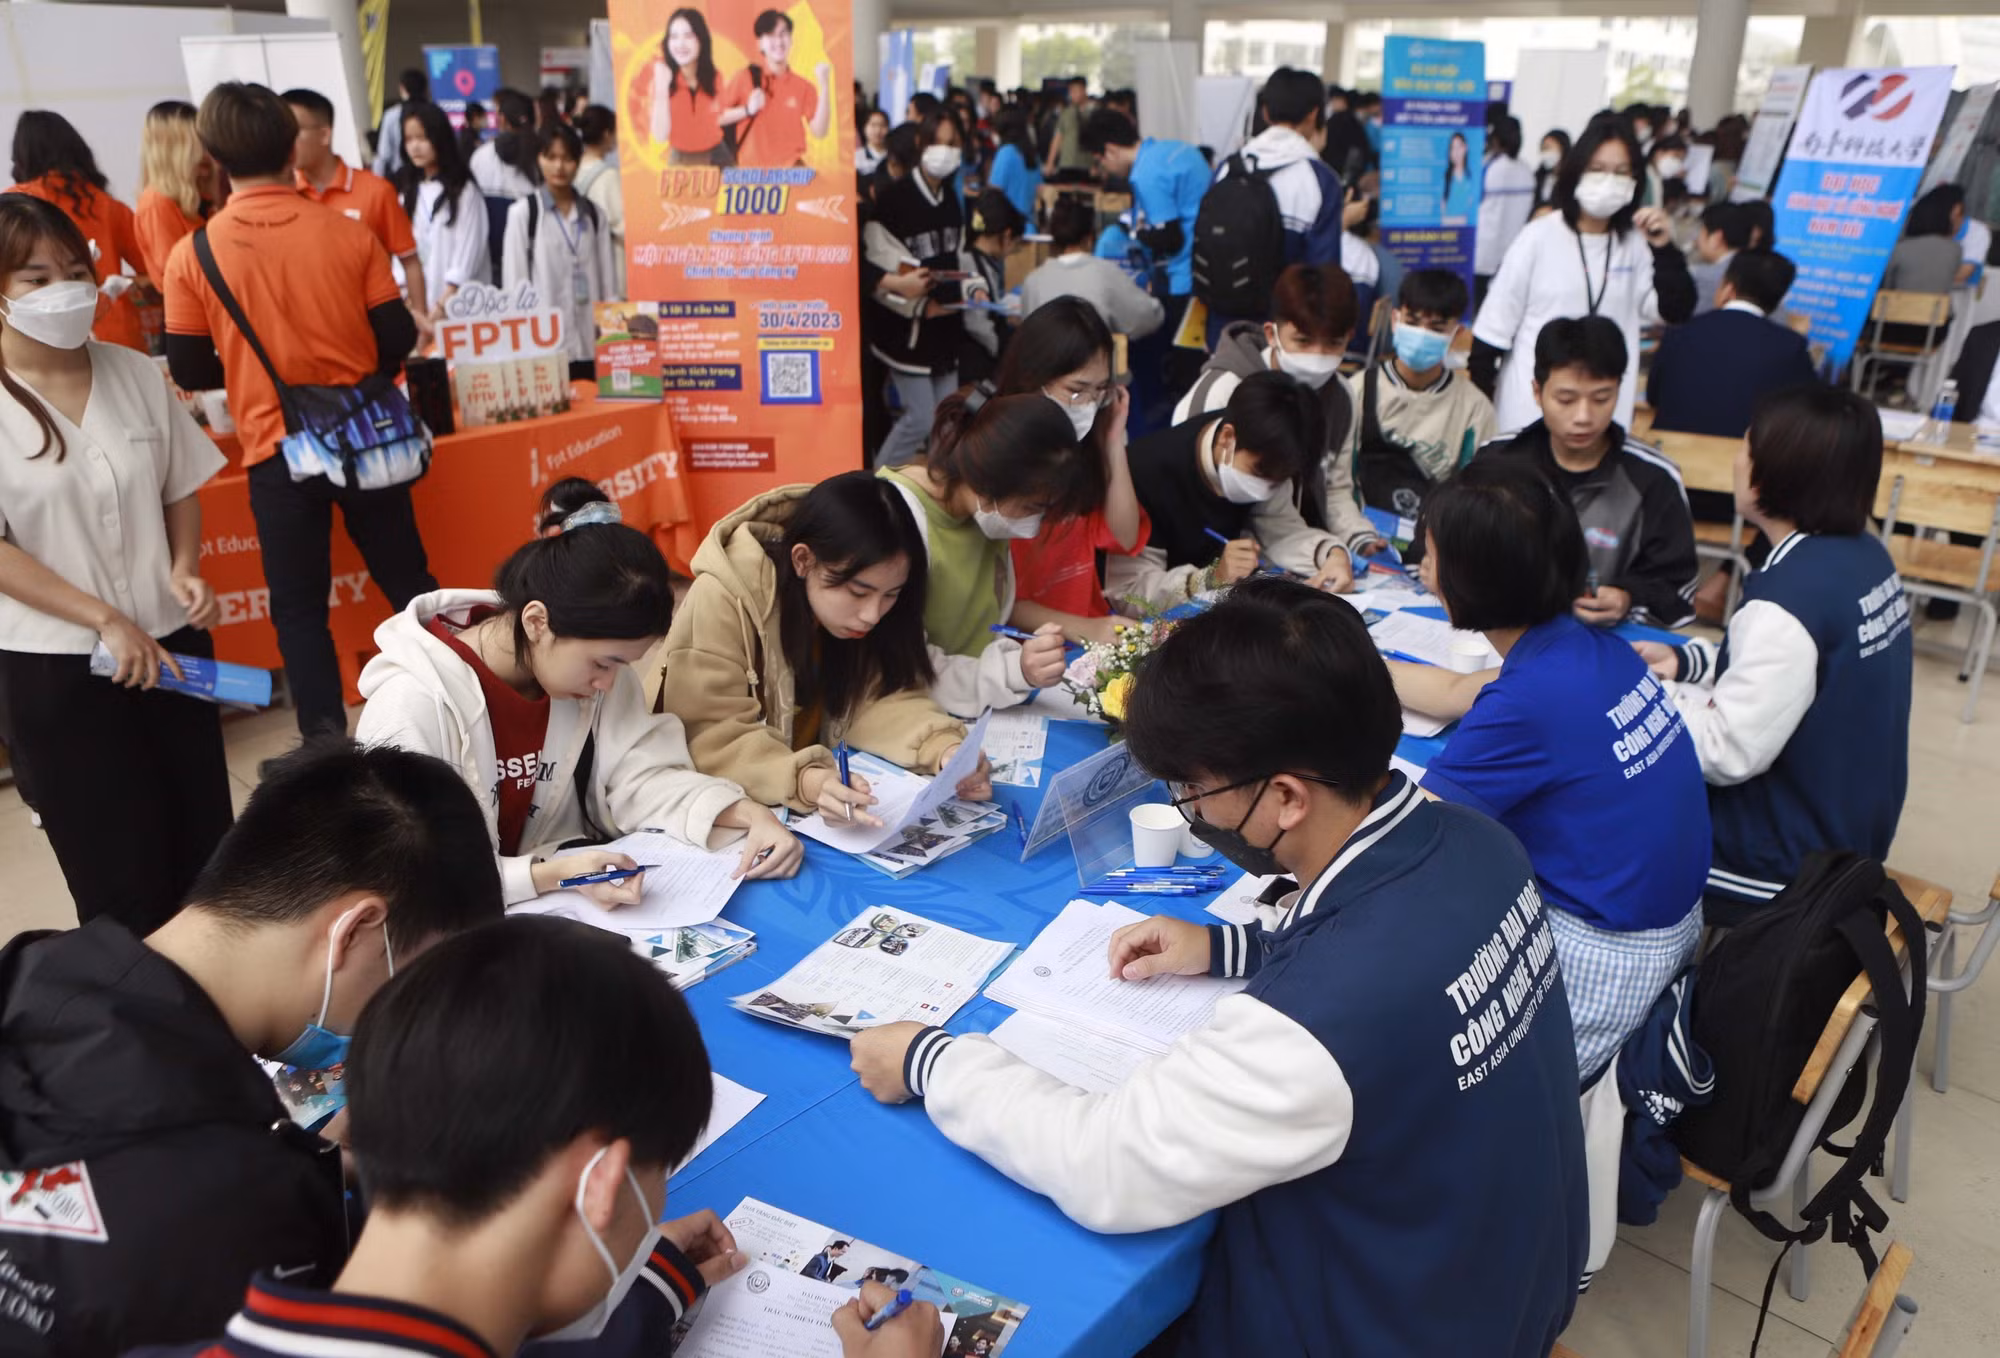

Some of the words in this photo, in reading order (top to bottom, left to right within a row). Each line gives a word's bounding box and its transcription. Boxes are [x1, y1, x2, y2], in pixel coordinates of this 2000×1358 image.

[660, 168, 720, 197] FPTU
[722, 167, 817, 184] SCHOLARSHIP
[724, 185, 783, 215] 1000
[442, 313, 560, 360] FPTU
[759, 312, 841, 329] 30/4/2023
[546, 449, 567, 470] Fpt
[567, 425, 622, 459] Education
[1606, 689, 1647, 730] TRƯỜNG
[1612, 724, 1653, 763] CÔNG
[1623, 759, 1646, 779] EAST
[1645, 750, 1660, 767] ASIA
[1445, 932, 1510, 1016] TRƯỜNG
[1499, 905, 1527, 952] ĐẠI
[1516, 879, 1542, 926] HỌC
[1450, 999, 1506, 1067] CÔNG
[1502, 953, 1533, 1018] NGHỆ
[1526, 920, 1554, 978] ĐÔNG
[1457, 1062, 1490, 1091] EAST
[1489, 1041, 1510, 1071] ASIA
[1507, 998, 1539, 1050] UNIVERSITY
[1535, 984, 1544, 1004] OF
